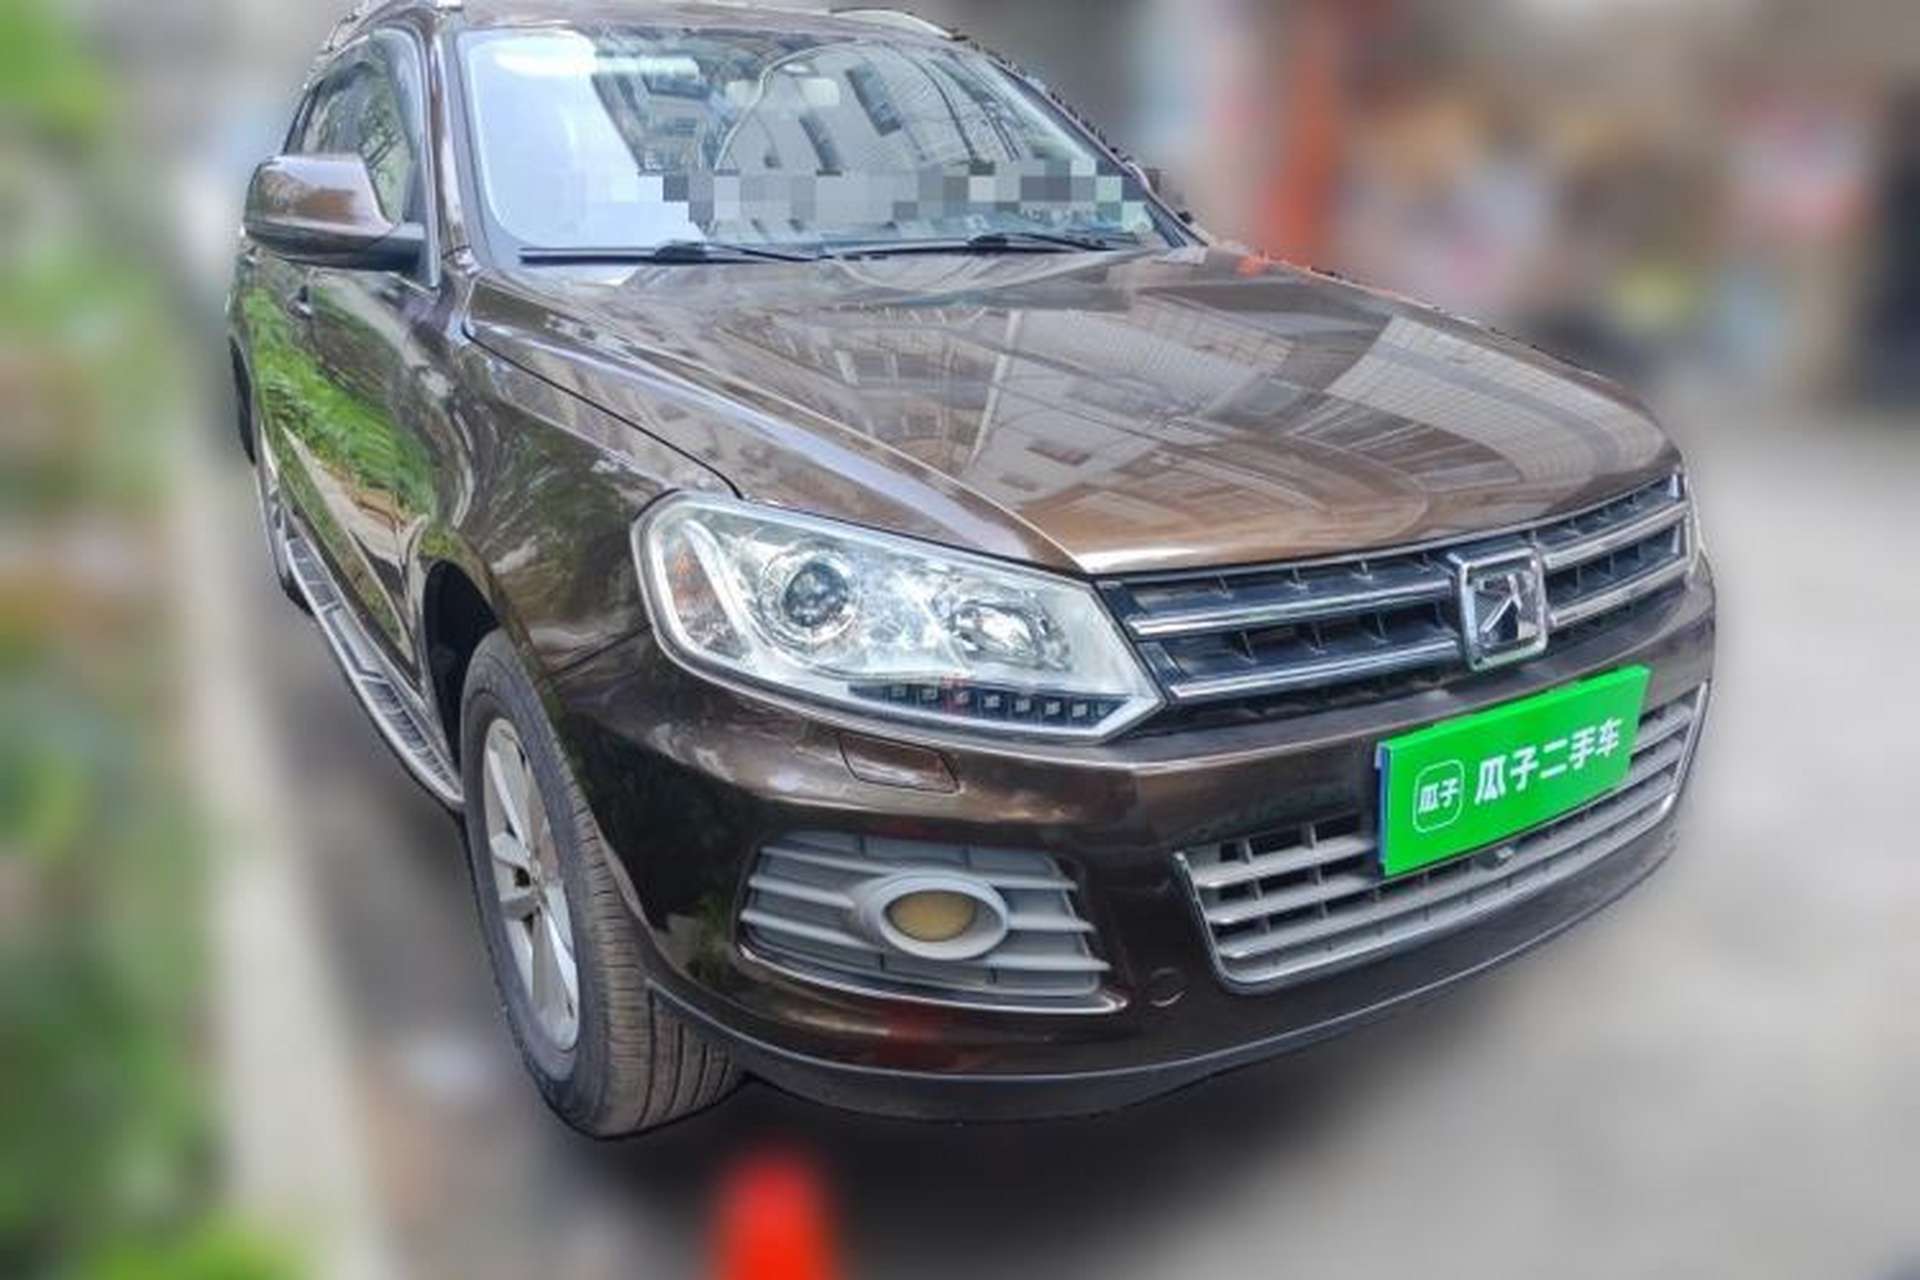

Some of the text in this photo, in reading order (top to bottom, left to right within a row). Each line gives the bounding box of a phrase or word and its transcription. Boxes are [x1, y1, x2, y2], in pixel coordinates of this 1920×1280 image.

[1475, 717, 1623, 805] 瓜子二手车
[1418, 778, 1460, 814] 瓜子
